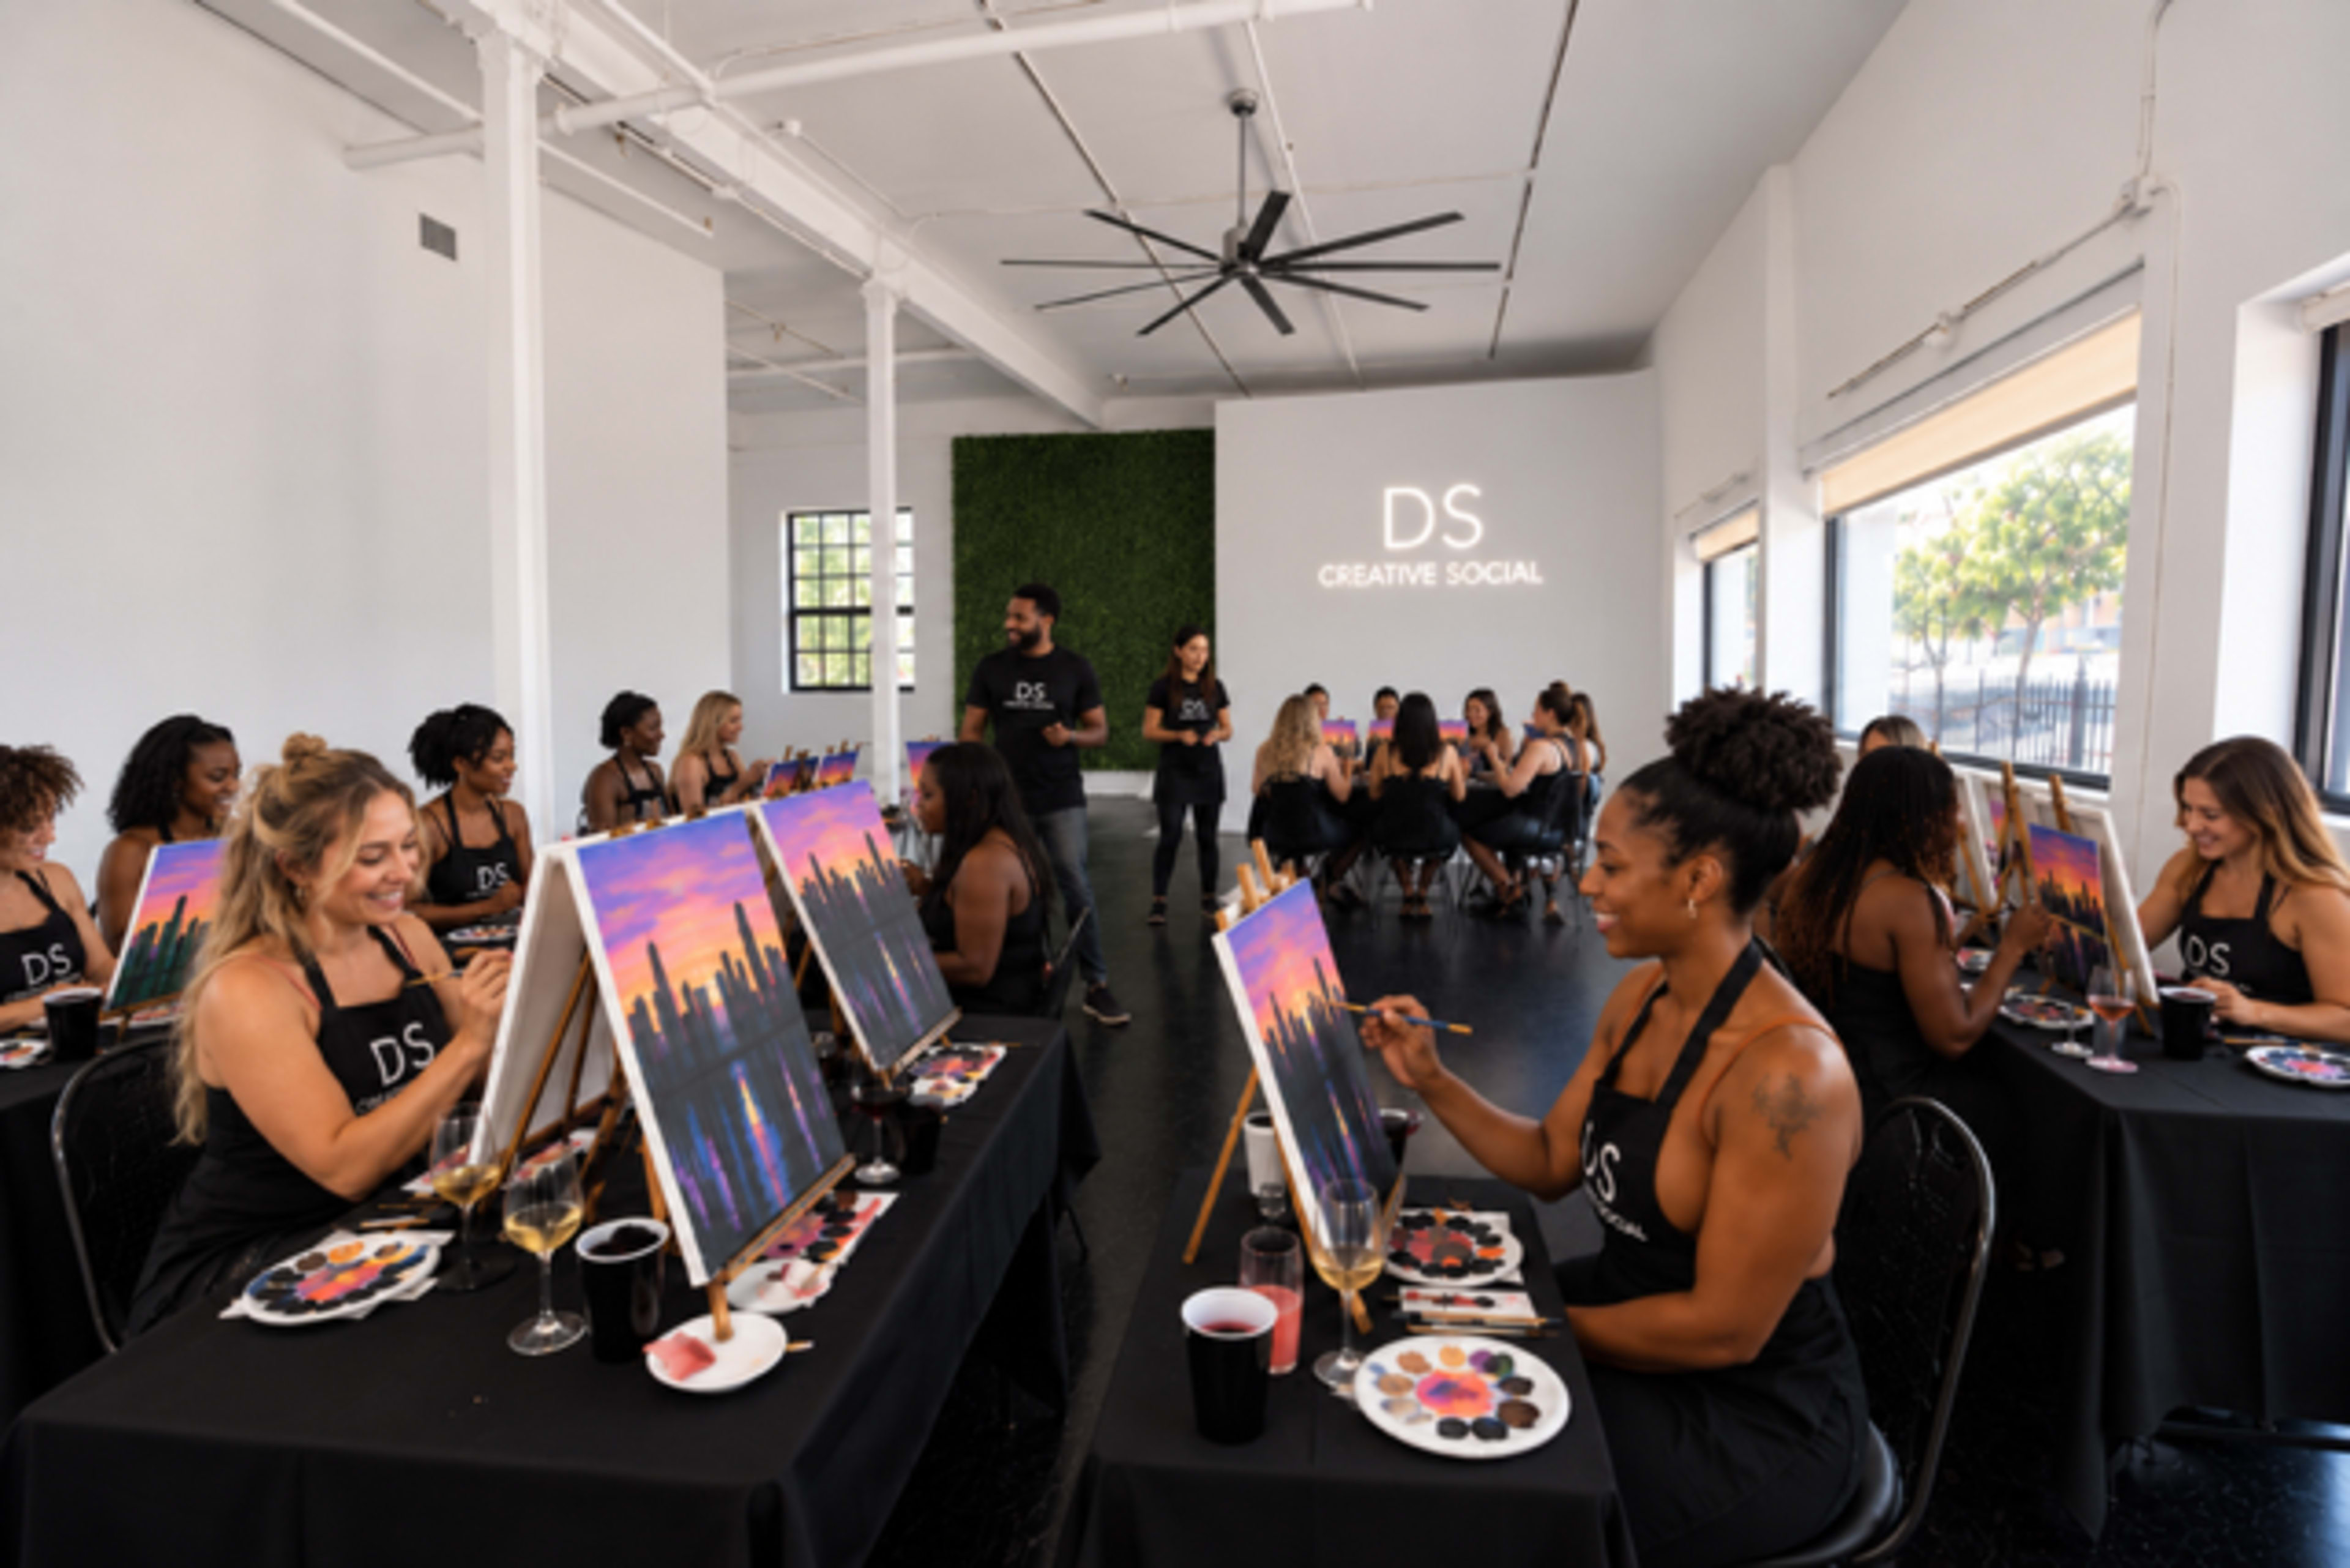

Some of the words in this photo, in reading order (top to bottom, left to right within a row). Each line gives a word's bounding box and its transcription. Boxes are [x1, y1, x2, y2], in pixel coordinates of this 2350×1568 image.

[1383, 483, 1483, 550] DS
[1318, 561, 1438, 588] CREATIVE
[1445, 560, 1544, 586] SOCIAL
[1016, 681, 1045, 701] DS
[21, 943, 72, 985] DS
[2185, 933, 2231, 975] DS
[370, 1021, 435, 1087] DS
